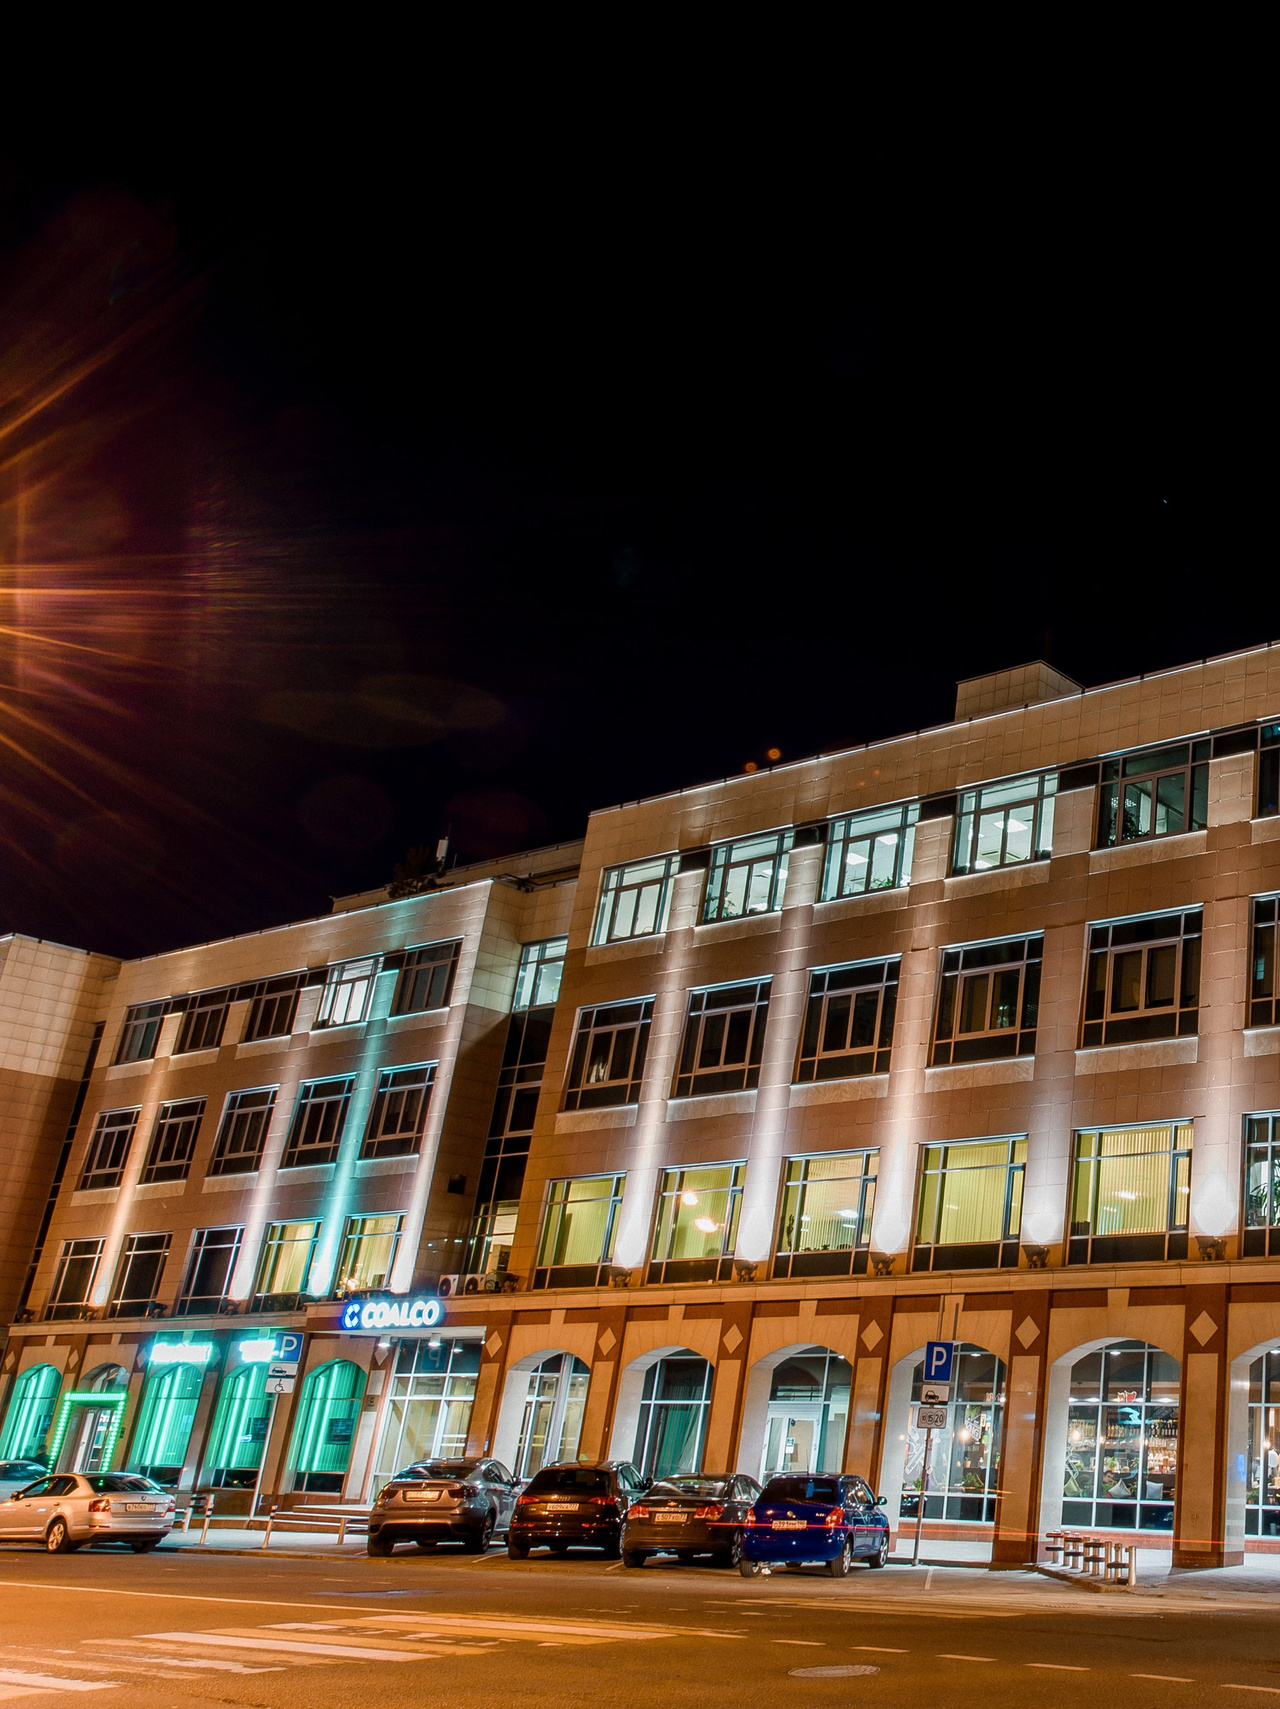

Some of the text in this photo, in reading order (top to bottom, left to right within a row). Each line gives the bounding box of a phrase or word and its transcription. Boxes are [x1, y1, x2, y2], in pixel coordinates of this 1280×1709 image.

[361, 1300, 440, 1328] COALCO
[279, 1335, 298, 1359] P
[931, 1346, 947, 1376] P
[928, 1414, 933, 1423] 15
[935, 1413, 943, 1423] 20
